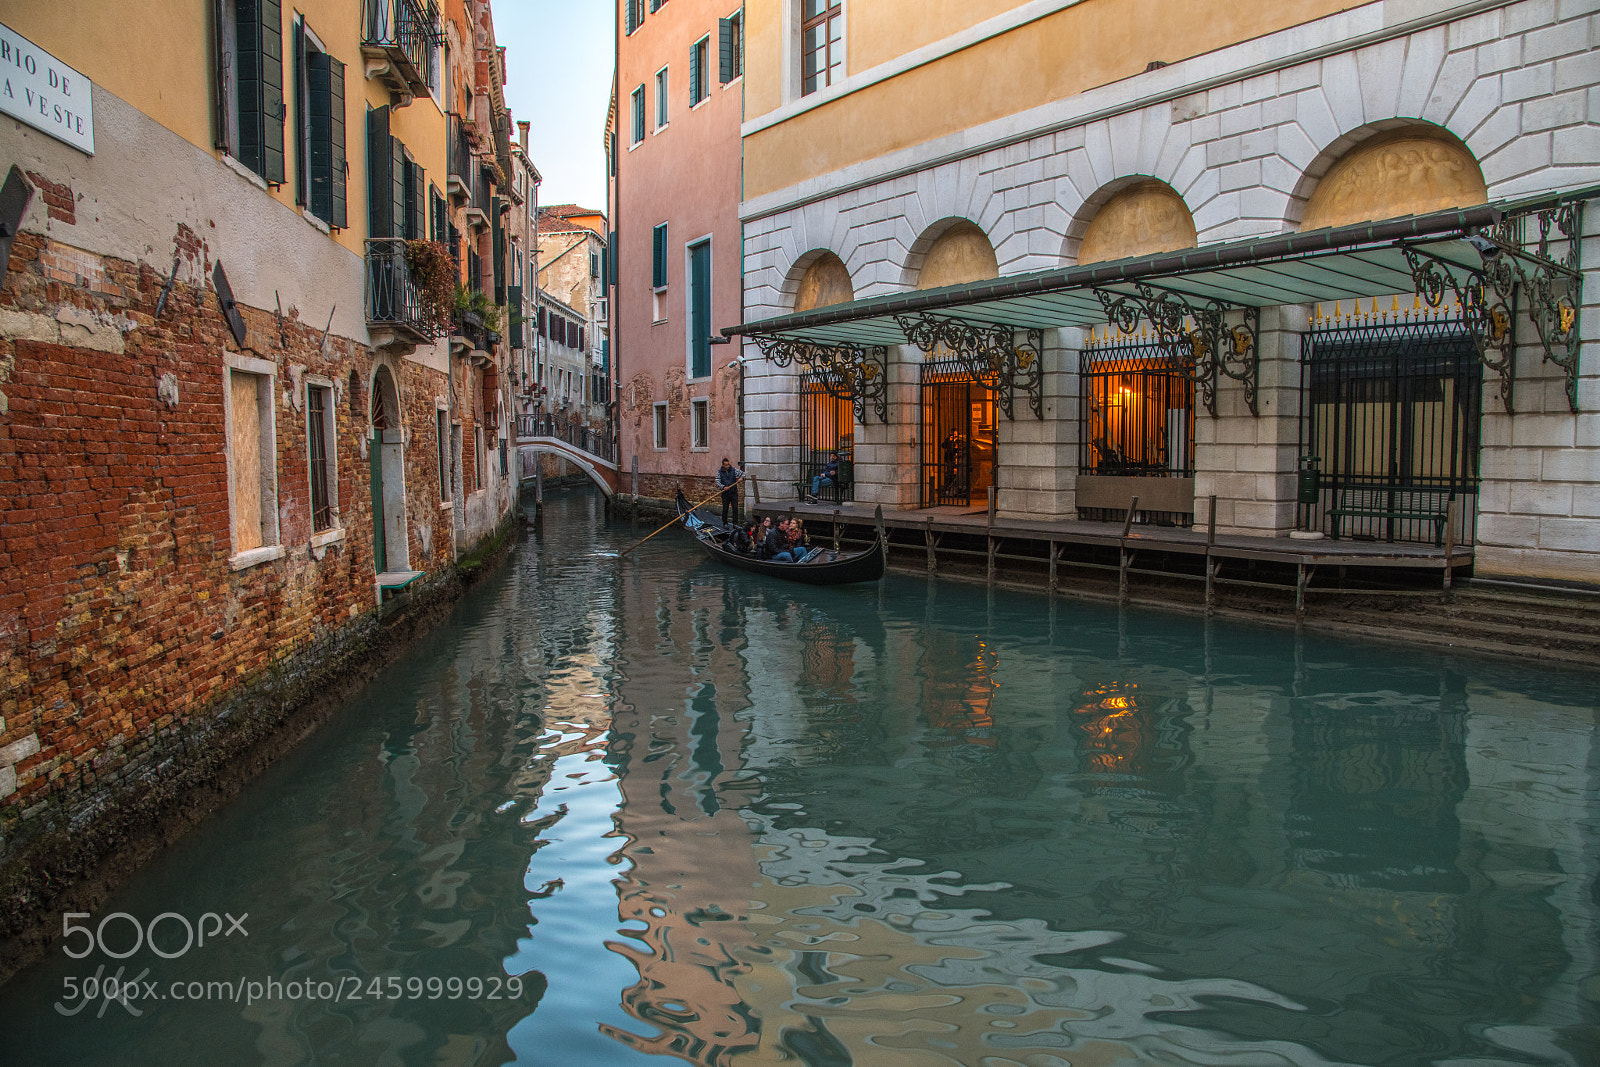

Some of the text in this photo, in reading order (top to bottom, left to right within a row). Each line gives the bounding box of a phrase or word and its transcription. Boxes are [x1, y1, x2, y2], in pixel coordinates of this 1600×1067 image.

[1, 38, 71, 97] RIO DE
[25, 86, 84, 136] VESTE
